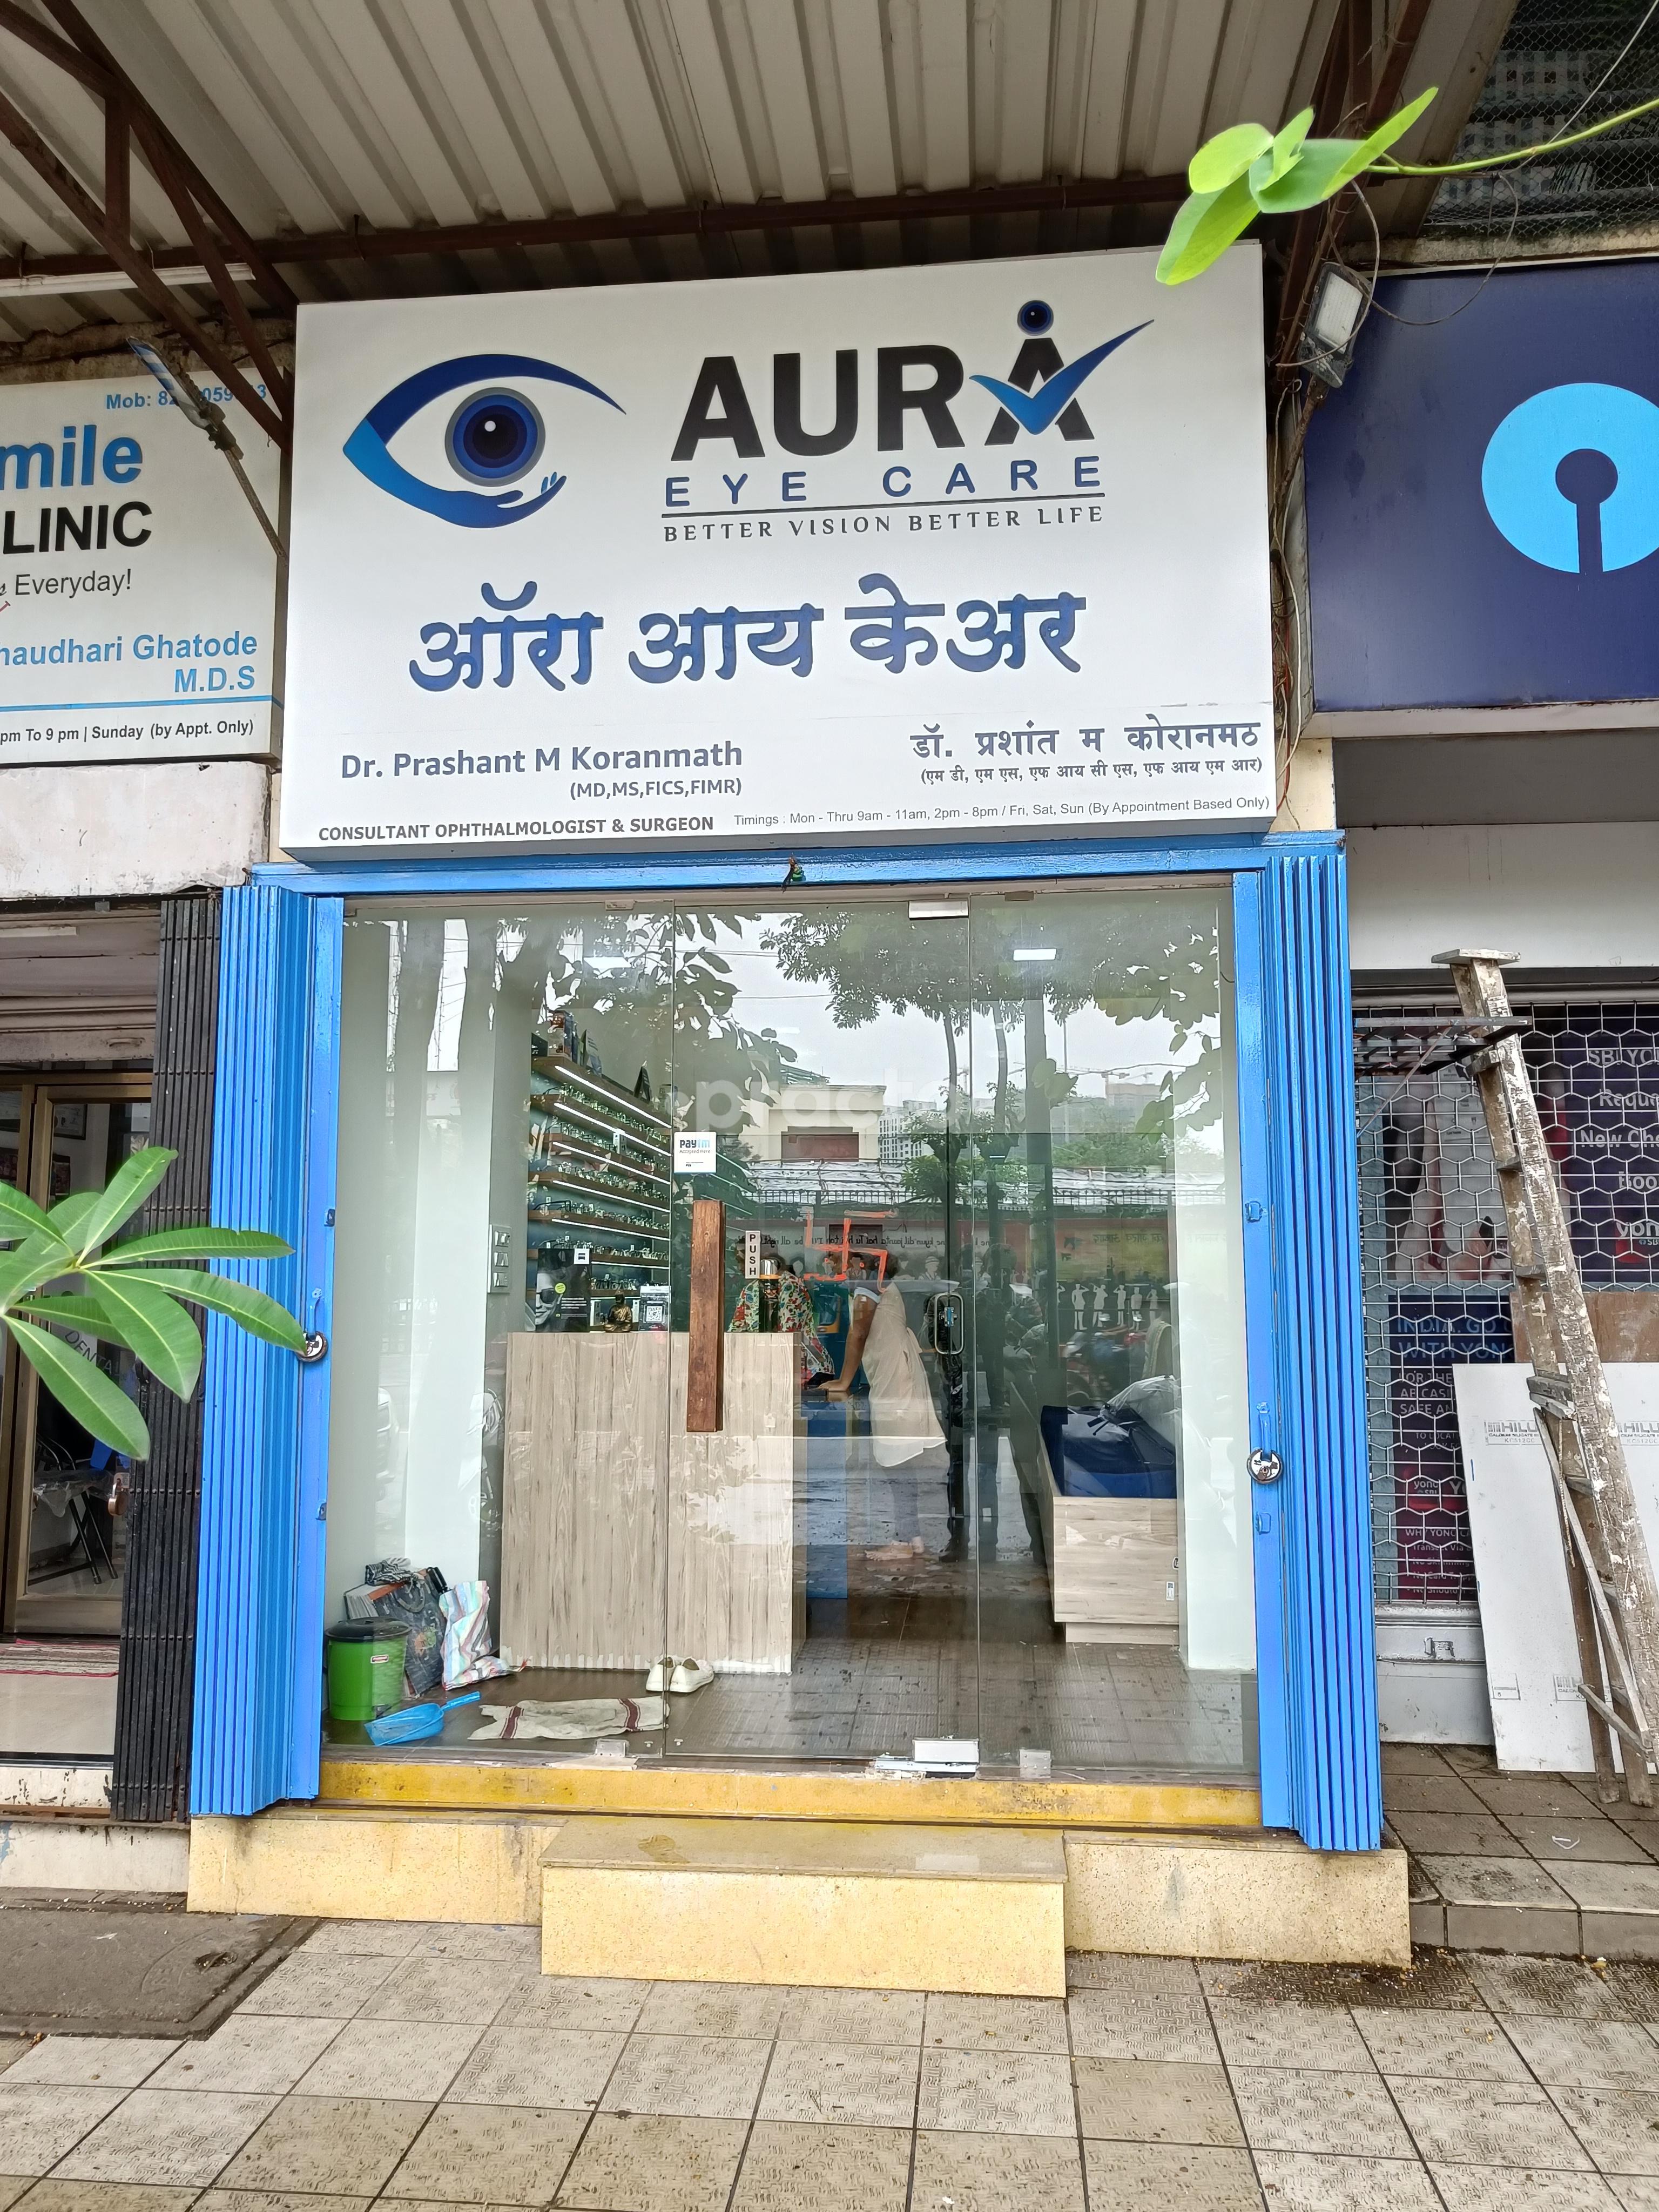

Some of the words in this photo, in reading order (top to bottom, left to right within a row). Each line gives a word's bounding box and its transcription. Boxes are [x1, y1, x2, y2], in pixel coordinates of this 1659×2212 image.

[106, 393, 151, 409] Mob:
[158, 384, 267, 406] 80593
[671, 338, 1095, 461] AURA
[0, 424, 143, 490] mile
[666, 471, 806, 507] EYE
[882, 456, 1100, 497] CARE
[3, 501, 152, 554] LINIC
[664, 522, 772, 542] BETTER
[788, 516, 889, 536] VISION
[909, 511, 1020, 531] BETTER
[1038, 507, 1102, 524] LIFE
[15, 569, 131, 598] Everyday!
[629, 603, 824, 684] आय
[845, 574, 1086, 673] केअर
[133, 631, 257, 661] Ghatode
[175, 666, 255, 693] M.D.S
[26, 729, 42, 741] To
[46, 728, 53, 740] 9
[58, 729, 79, 743] pm
[92, 725, 144, 740] Sunday
[150, 724, 171, 739] (by
[176, 722, 212, 736] Appt.
[217, 720, 253, 736] Only)
[910, 724, 952, 758] डॉ.
[975, 720, 1059, 757] प्रशांत
[1079, 729, 1104, 752] म
[1124, 714, 1261, 751] कोरानमठ
[342, 756, 382, 778] Dr.
[394, 750, 525, 776] Prashant
[536, 747, 559, 772] M
[572, 741, 741, 770] Koranmath
[975, 769, 994, 783] एम
[1029, 767, 1050, 781] एफ
[1057, 766, 1085, 777] आय
[1090, 760, 1108, 777] सी
[1143, 763, 1164, 777] एफ
[1171, 761, 1200, 773] आय
[1205, 760, 1225, 775] एम
[571, 778, 741, 800] (MD,MS,FICS,FIMR)
[734, 815, 778, 826] Timings
[791, 813, 814, 823] Mon
[827, 812, 853, 821] Thru
[858, 811, 882, 821] 9am
[896, 810, 929, 820] 11am,
[935, 808, 960, 820] 2pm
[973, 807, 997, 819] 8pm
[1010, 805, 1028, 816] Fri,
[1033, 805, 1056, 815] Sat,
[1061, 804, 1083, 813] Sun
[1089, 803, 1109, 815] (By
[1112, 800, 1189, 814] Appointment
[1194, 798, 1231, 810] Based
[1237, 797, 1269, 810] Only)
[319, 825, 430, 840] CONSULTANT
[436, 820, 606, 837] OPHTHALMOLOGIST
[612, 819, 624, 832] &
[630, 817, 713, 832] SURGEON
[1581, 1130, 1622, 1148] New
